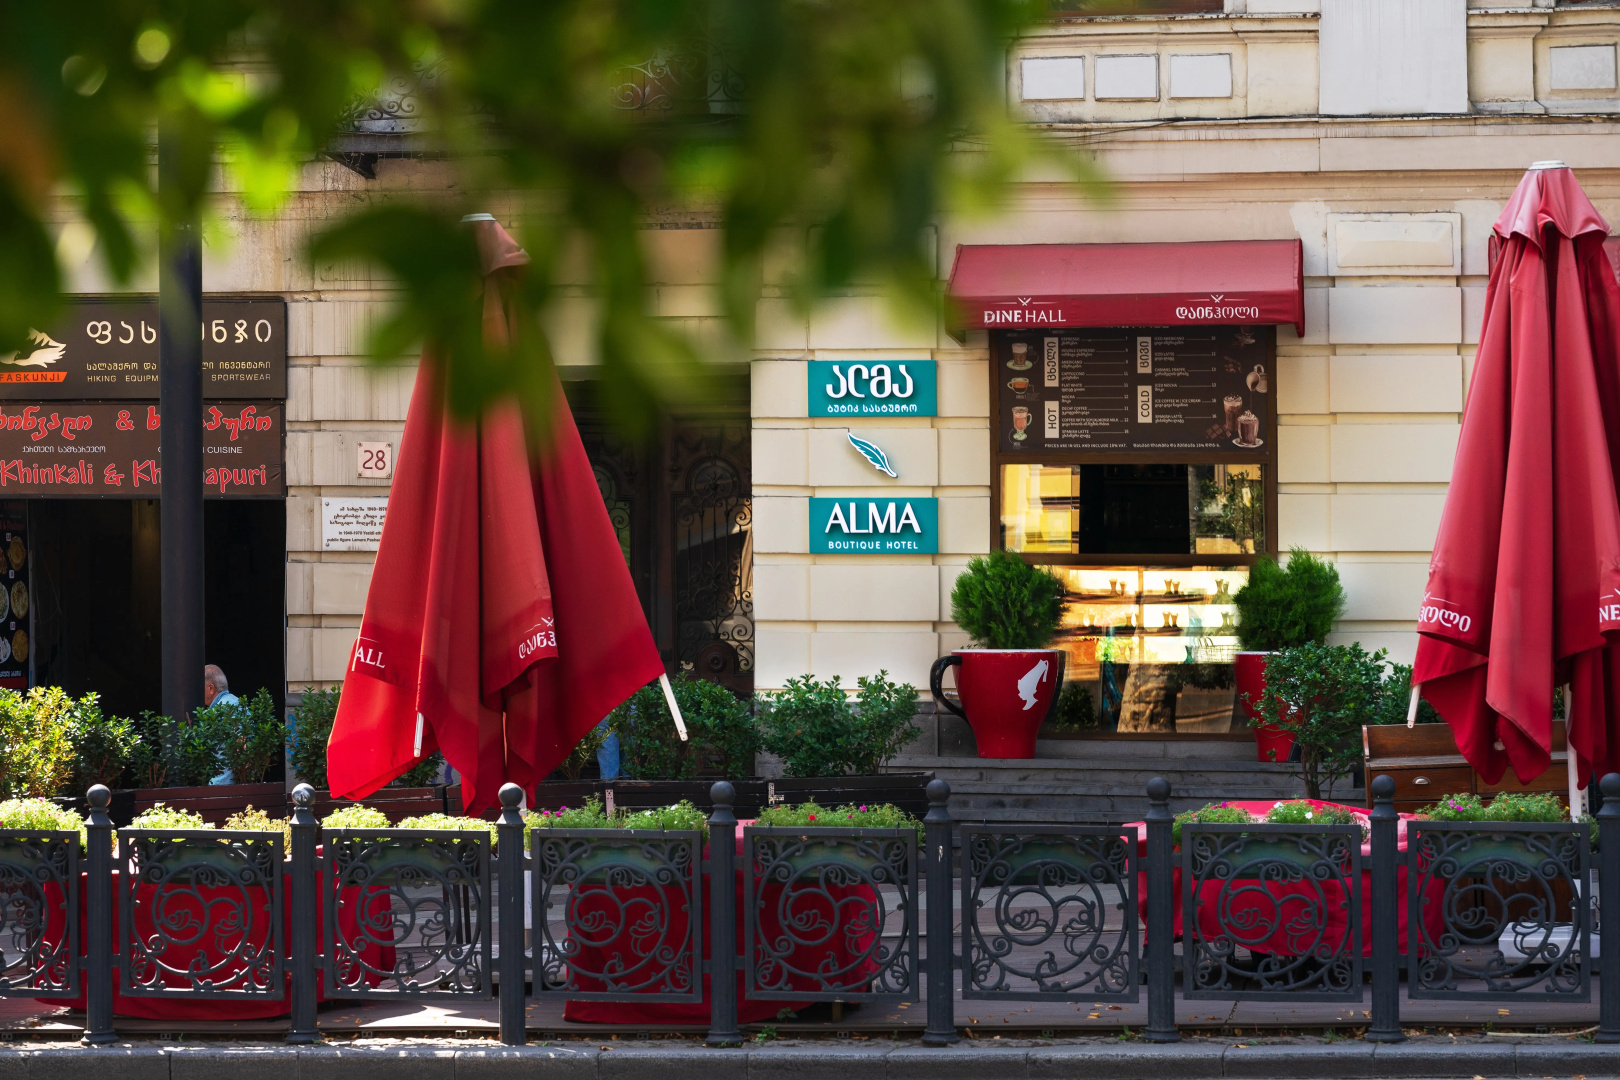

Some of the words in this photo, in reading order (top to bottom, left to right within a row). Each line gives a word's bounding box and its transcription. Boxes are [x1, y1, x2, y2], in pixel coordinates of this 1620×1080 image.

[87, 320, 272, 345] ფასნჯი
[1139, 340, 1150, 368] ცივი
[0, 373, 60, 381] FASKUNJI
[143, 362, 157, 370] და
[826, 364, 914, 398] ალმა
[827, 404, 859, 413] ბუტიკ
[862, 404, 918, 413] სასტუმრო
[1140, 390, 1150, 418] COLD
[116, 410, 135, 430] &
[146, 405, 273, 441] ხპური
[1048, 407, 1057, 429] HOT
[207, 446, 243, 454] CUISINE
[363, 450, 386, 470] 28
[0, 459, 94, 487] Khinkali
[103, 462, 126, 486] &
[133, 459, 267, 493] Khapuri
[825, 502, 922, 534] ALMA
[828, 541, 881, 550] BOUTIQUE
[886, 541, 919, 549] HOTEL
[1599, 604, 1620, 623] NE
[356, 645, 386, 669] ALL
